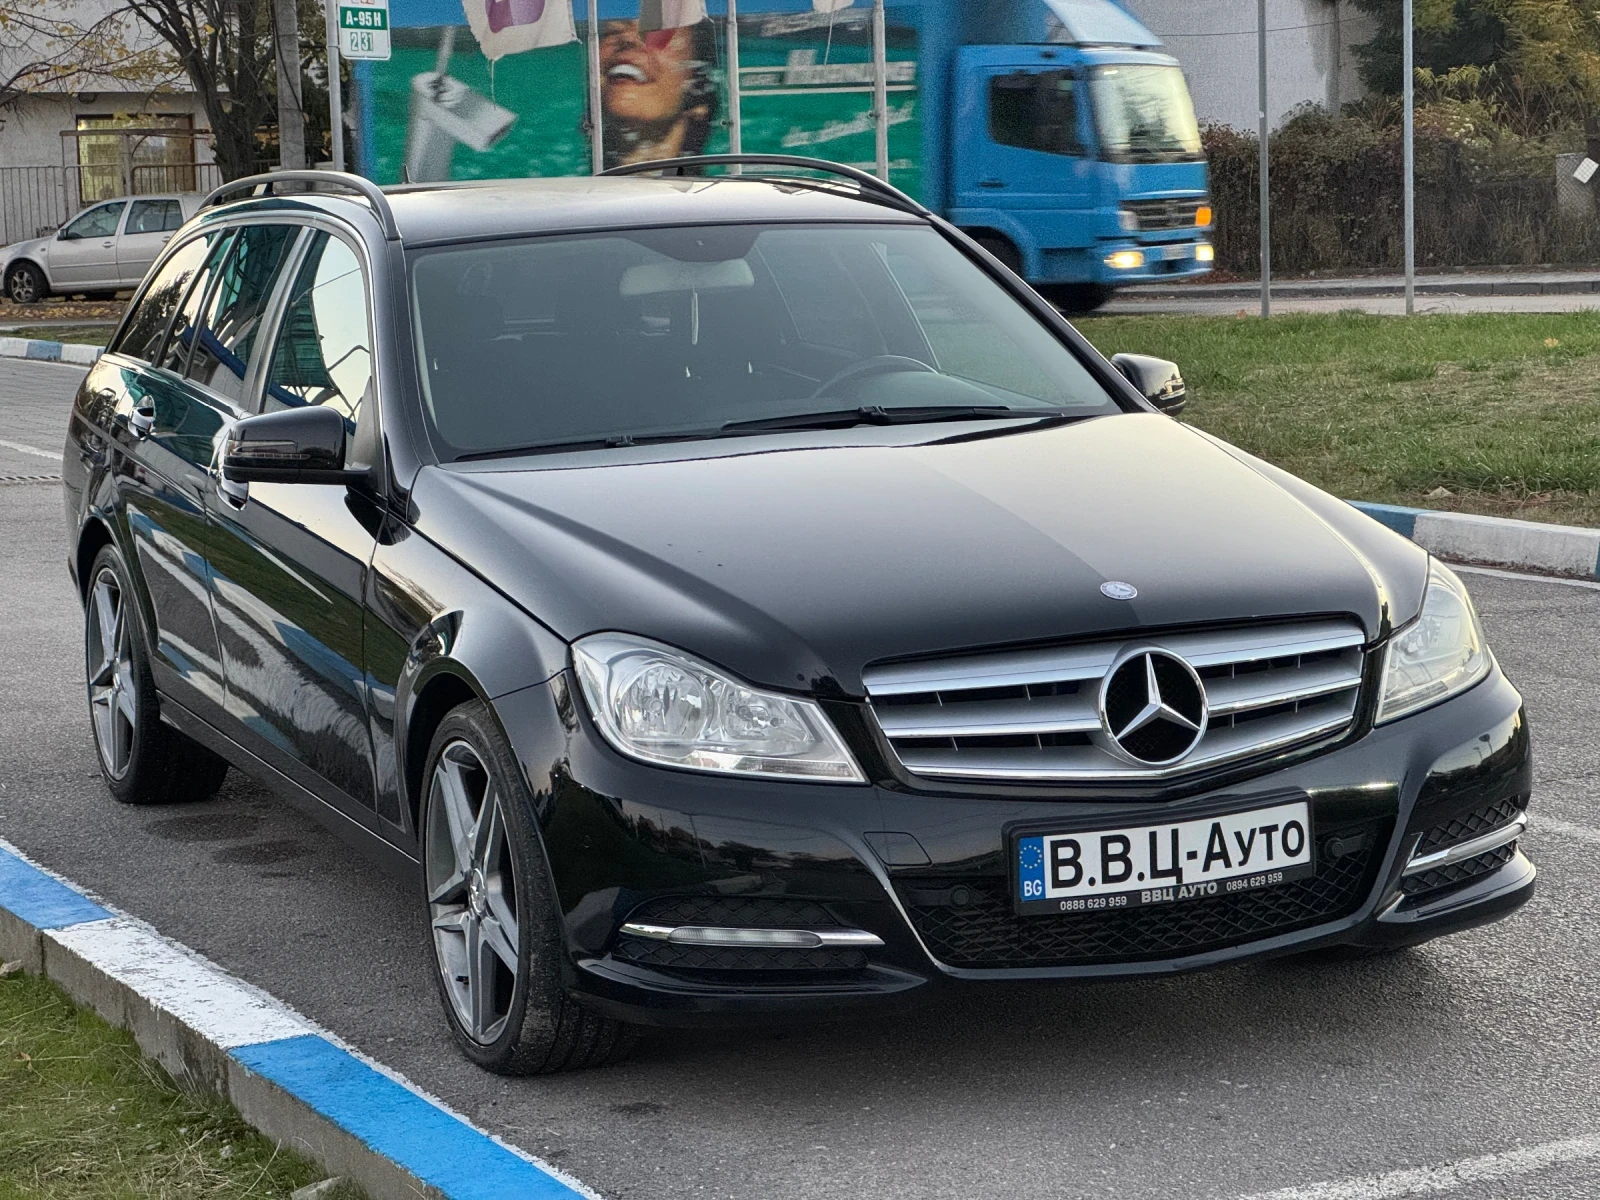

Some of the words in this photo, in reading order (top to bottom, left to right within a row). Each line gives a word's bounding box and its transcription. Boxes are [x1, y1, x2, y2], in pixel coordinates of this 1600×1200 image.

[1023, 879, 1042, 897] BG
[1060, 900, 1085, 911] 0888
[1087, 898, 1106, 909] 629
[1108, 896, 1127, 907] 959
[1141, 888, 1174, 903] ВВЦ
[1178, 882, 1218, 899] АУТО
[1226, 878, 1249, 891] 0894
[1250, 875, 1266, 887] 629
[1267, 872, 1283, 884] 959
